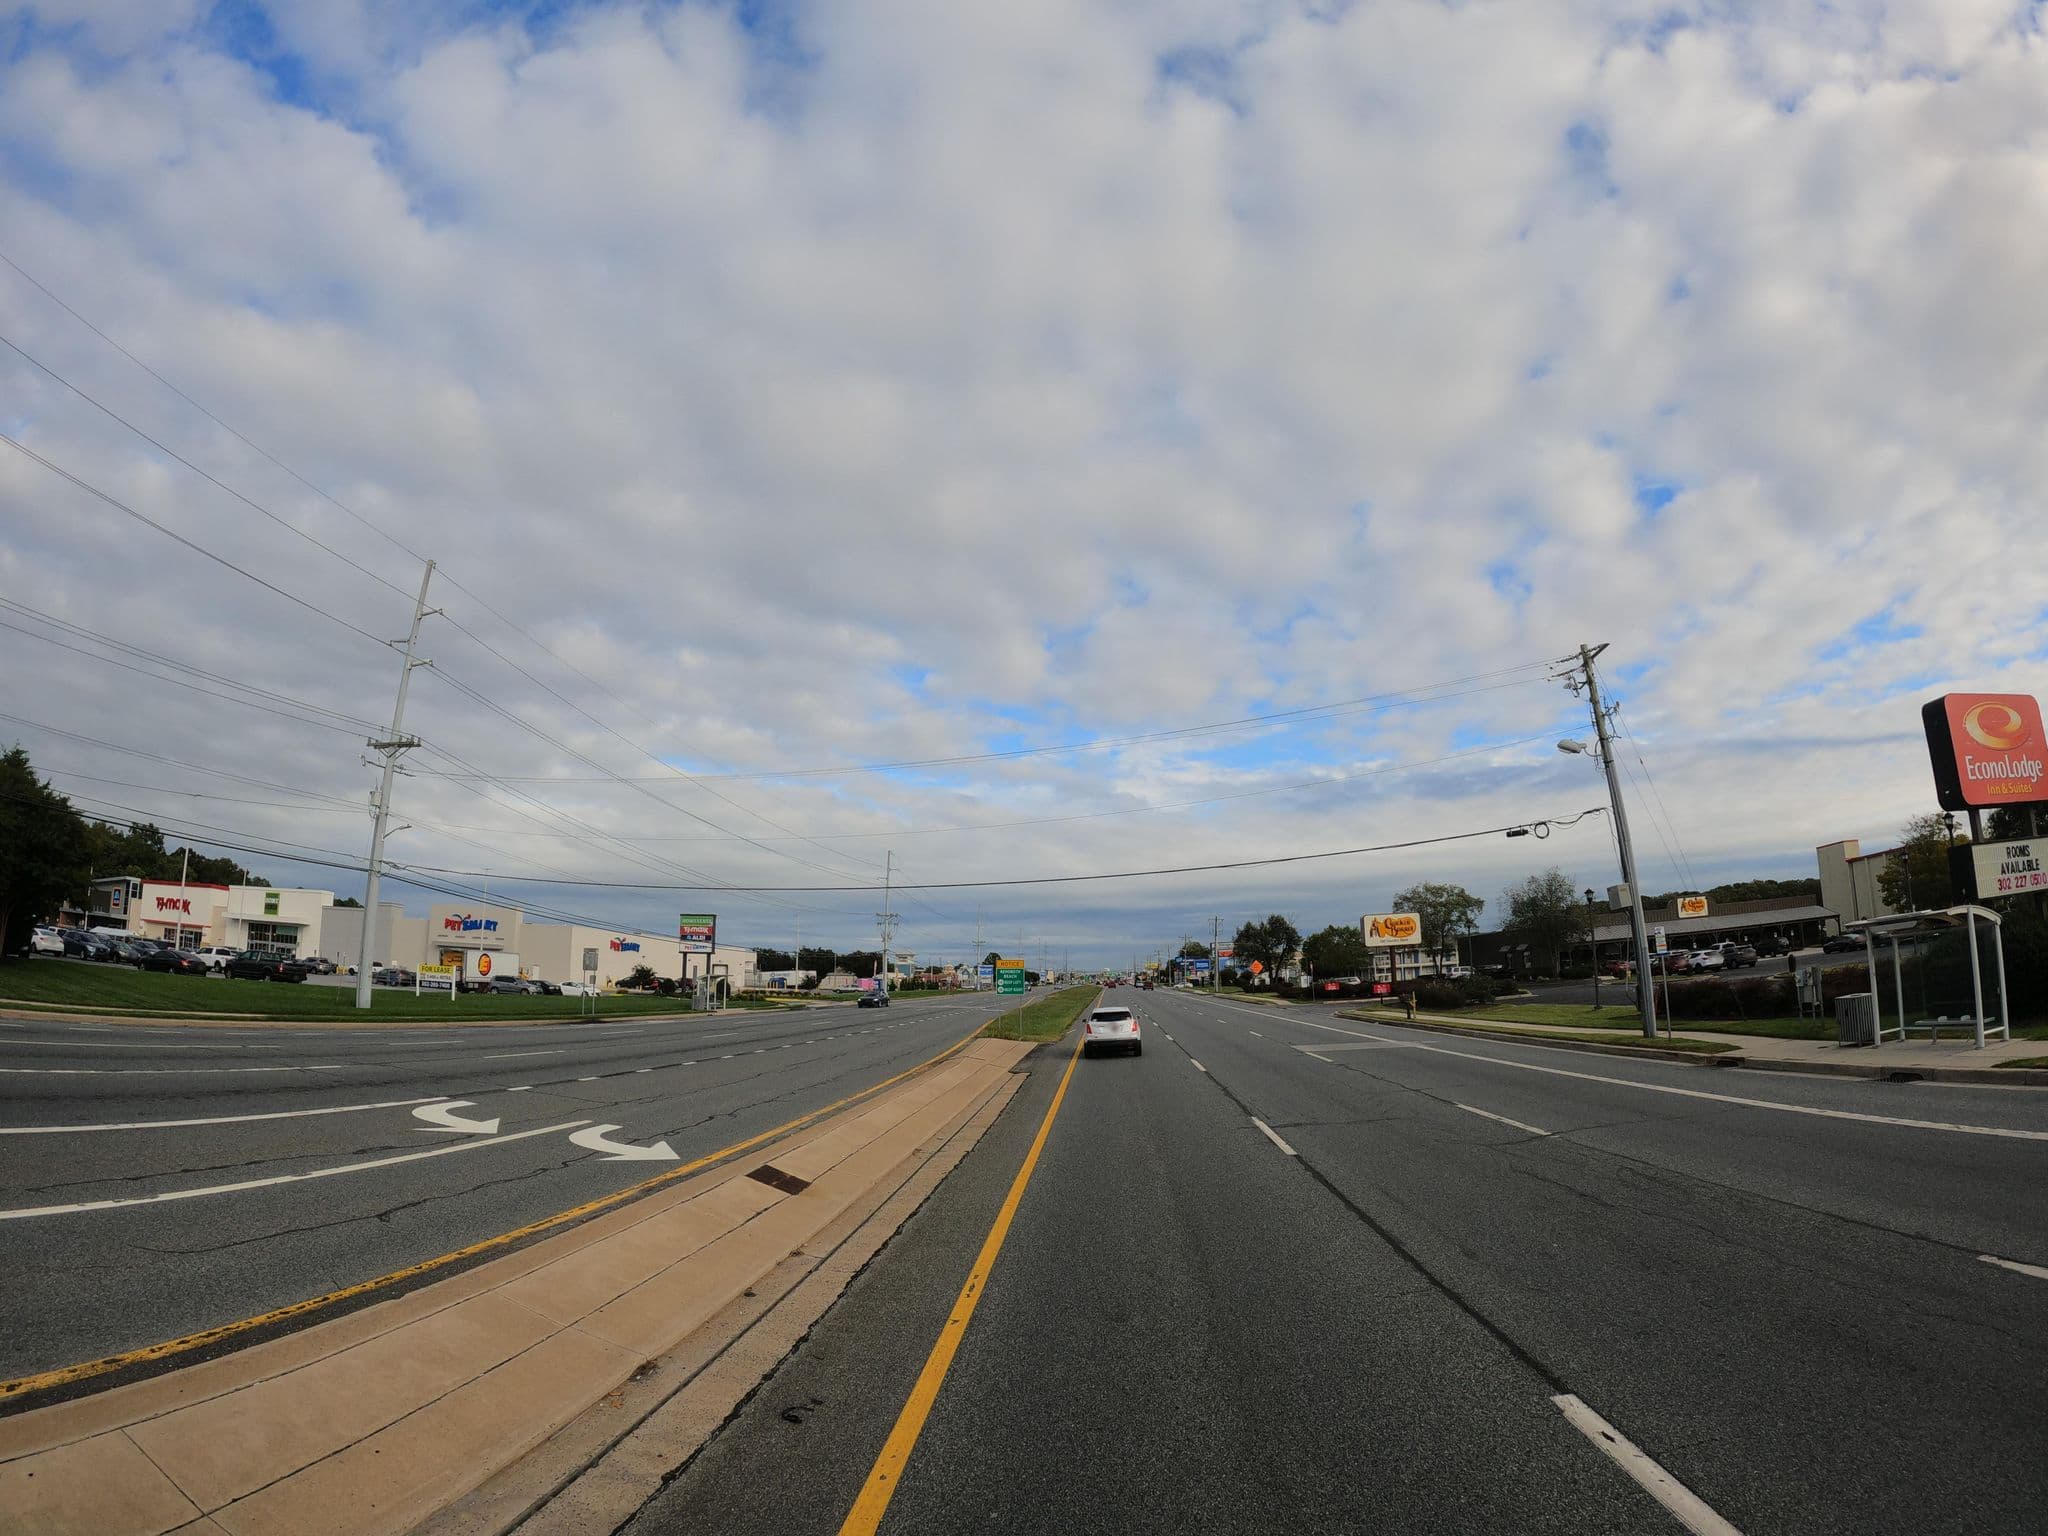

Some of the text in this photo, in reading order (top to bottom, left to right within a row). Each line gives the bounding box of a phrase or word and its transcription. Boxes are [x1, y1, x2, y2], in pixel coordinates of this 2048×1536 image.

[1965, 754, 2044, 783] EconoLodge
[2006, 845, 2031, 859] ROOMS
[2000, 858, 2040, 875] AVAILABLE
[1997, 877, 2012, 891] 302
[2014, 875, 2027, 889] 227
[434, 966, 452, 974] LEASE
